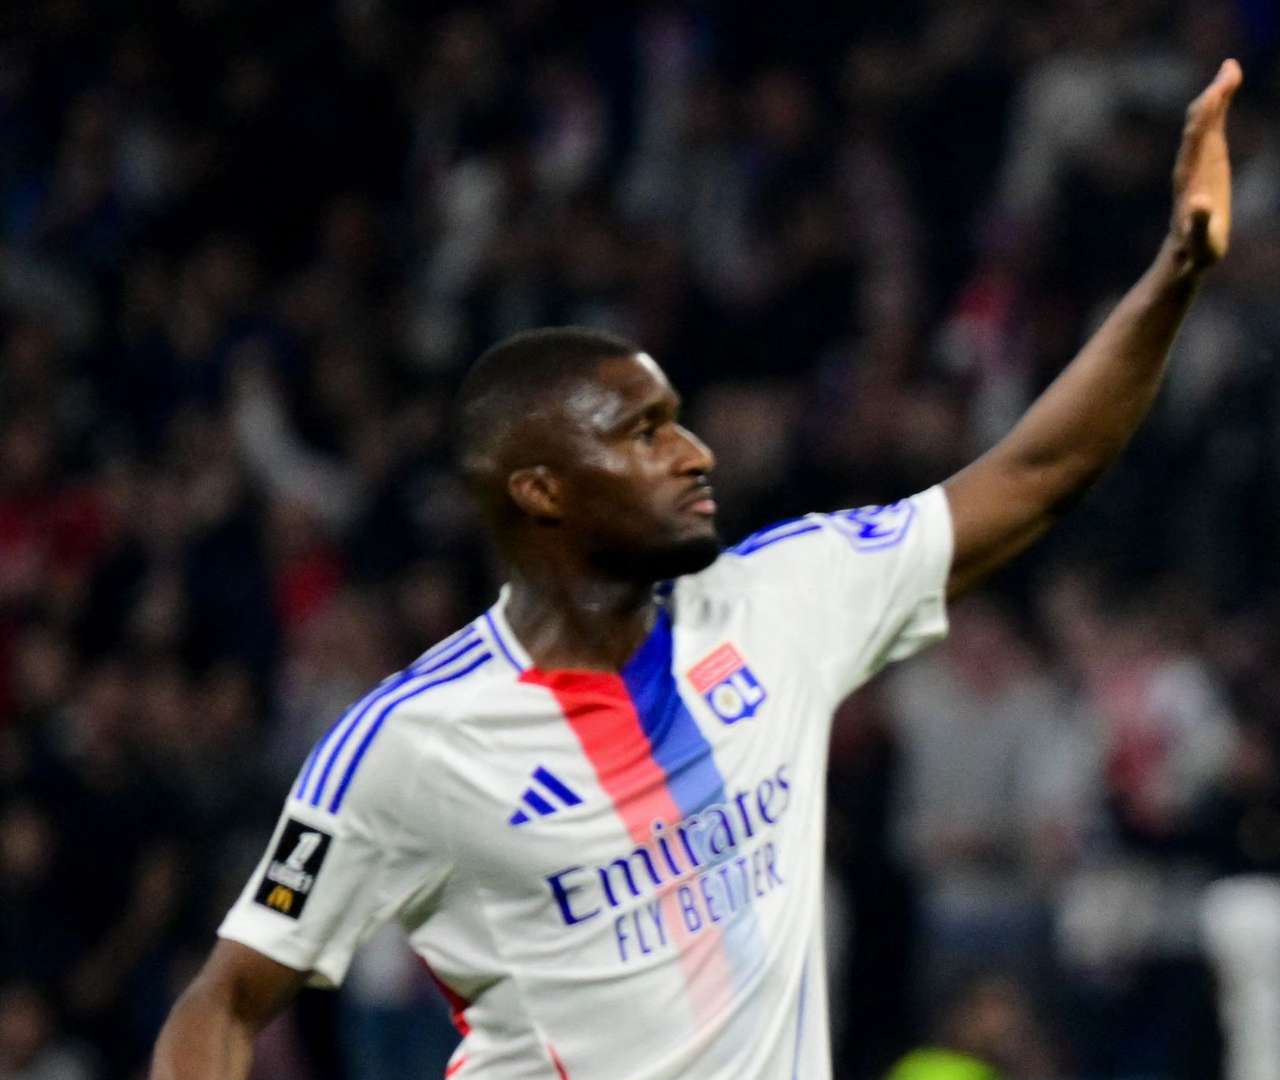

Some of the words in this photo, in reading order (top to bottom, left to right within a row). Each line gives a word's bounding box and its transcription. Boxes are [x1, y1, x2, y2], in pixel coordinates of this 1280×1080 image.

[544, 764, 791, 925] Emirates
[613, 897, 667, 962] FLY
[678, 842, 784, 933] BETTER
